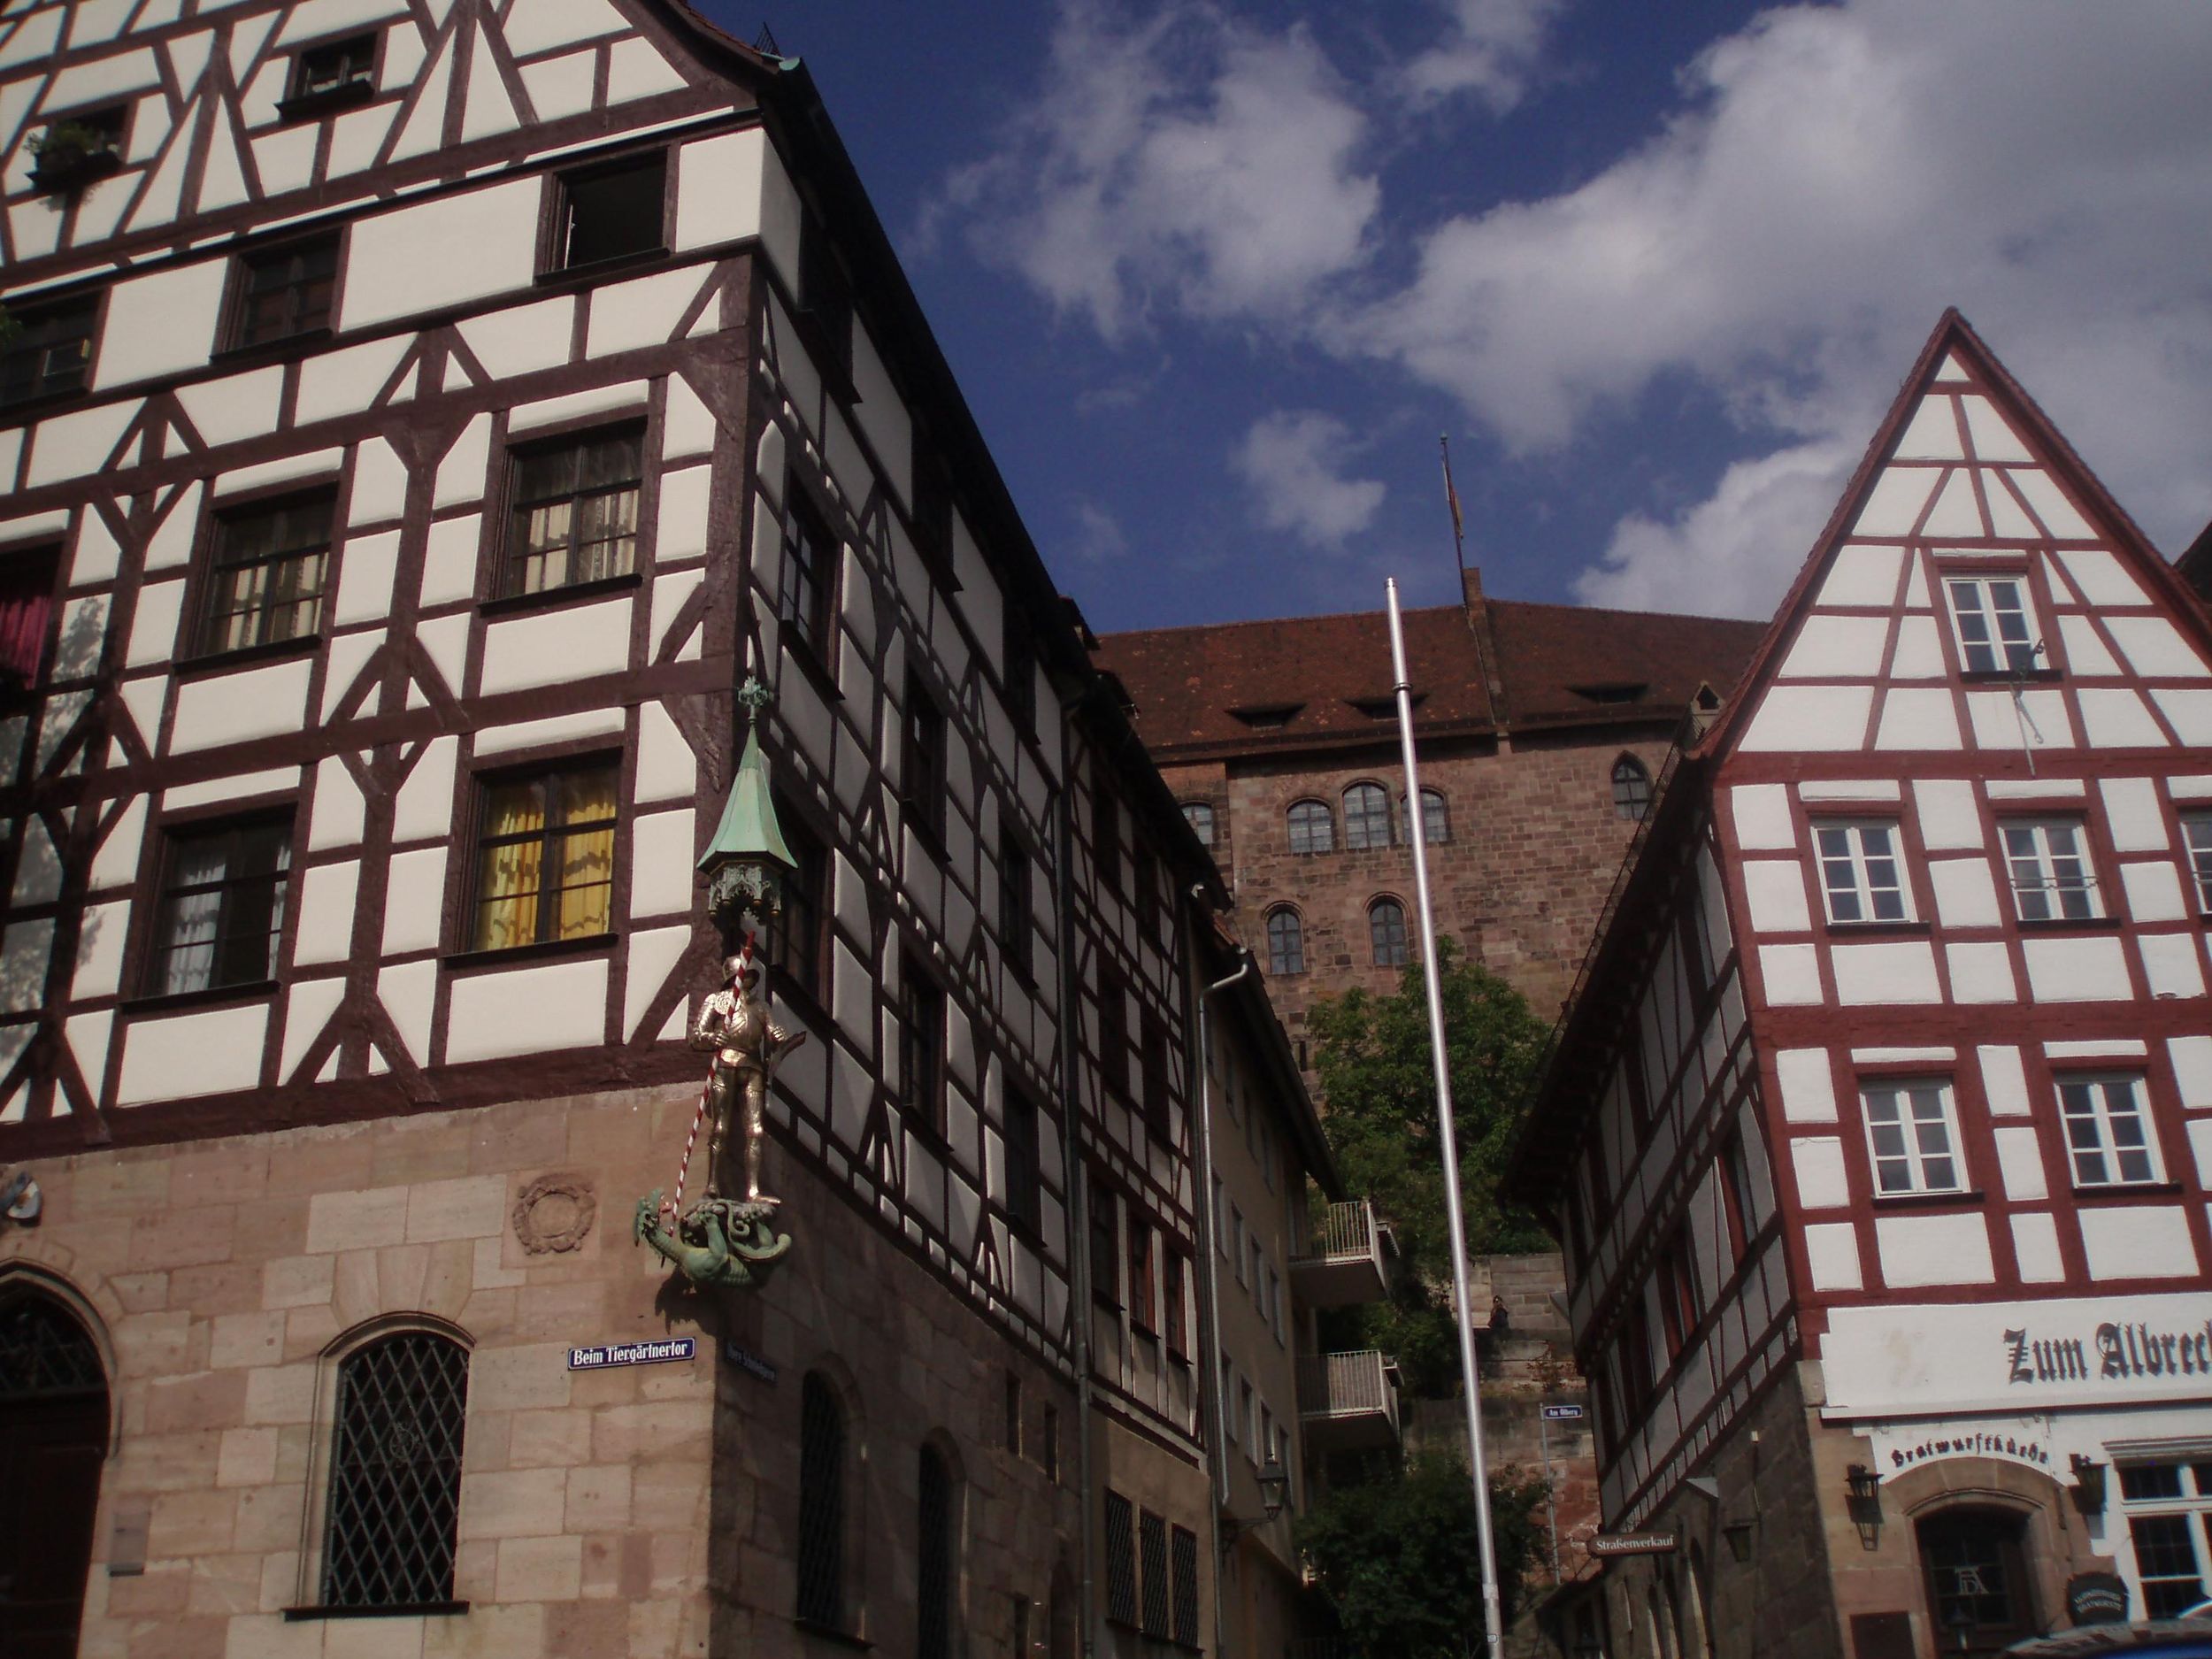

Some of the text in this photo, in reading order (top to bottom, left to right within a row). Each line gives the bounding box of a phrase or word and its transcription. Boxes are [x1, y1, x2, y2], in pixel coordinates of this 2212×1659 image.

[573, 1341, 687, 1365] Beim Tiergärtnertor
[2003, 1327, 2088, 1385] Zum
[1596, 1534, 1675, 1551] Straßenverkauf
